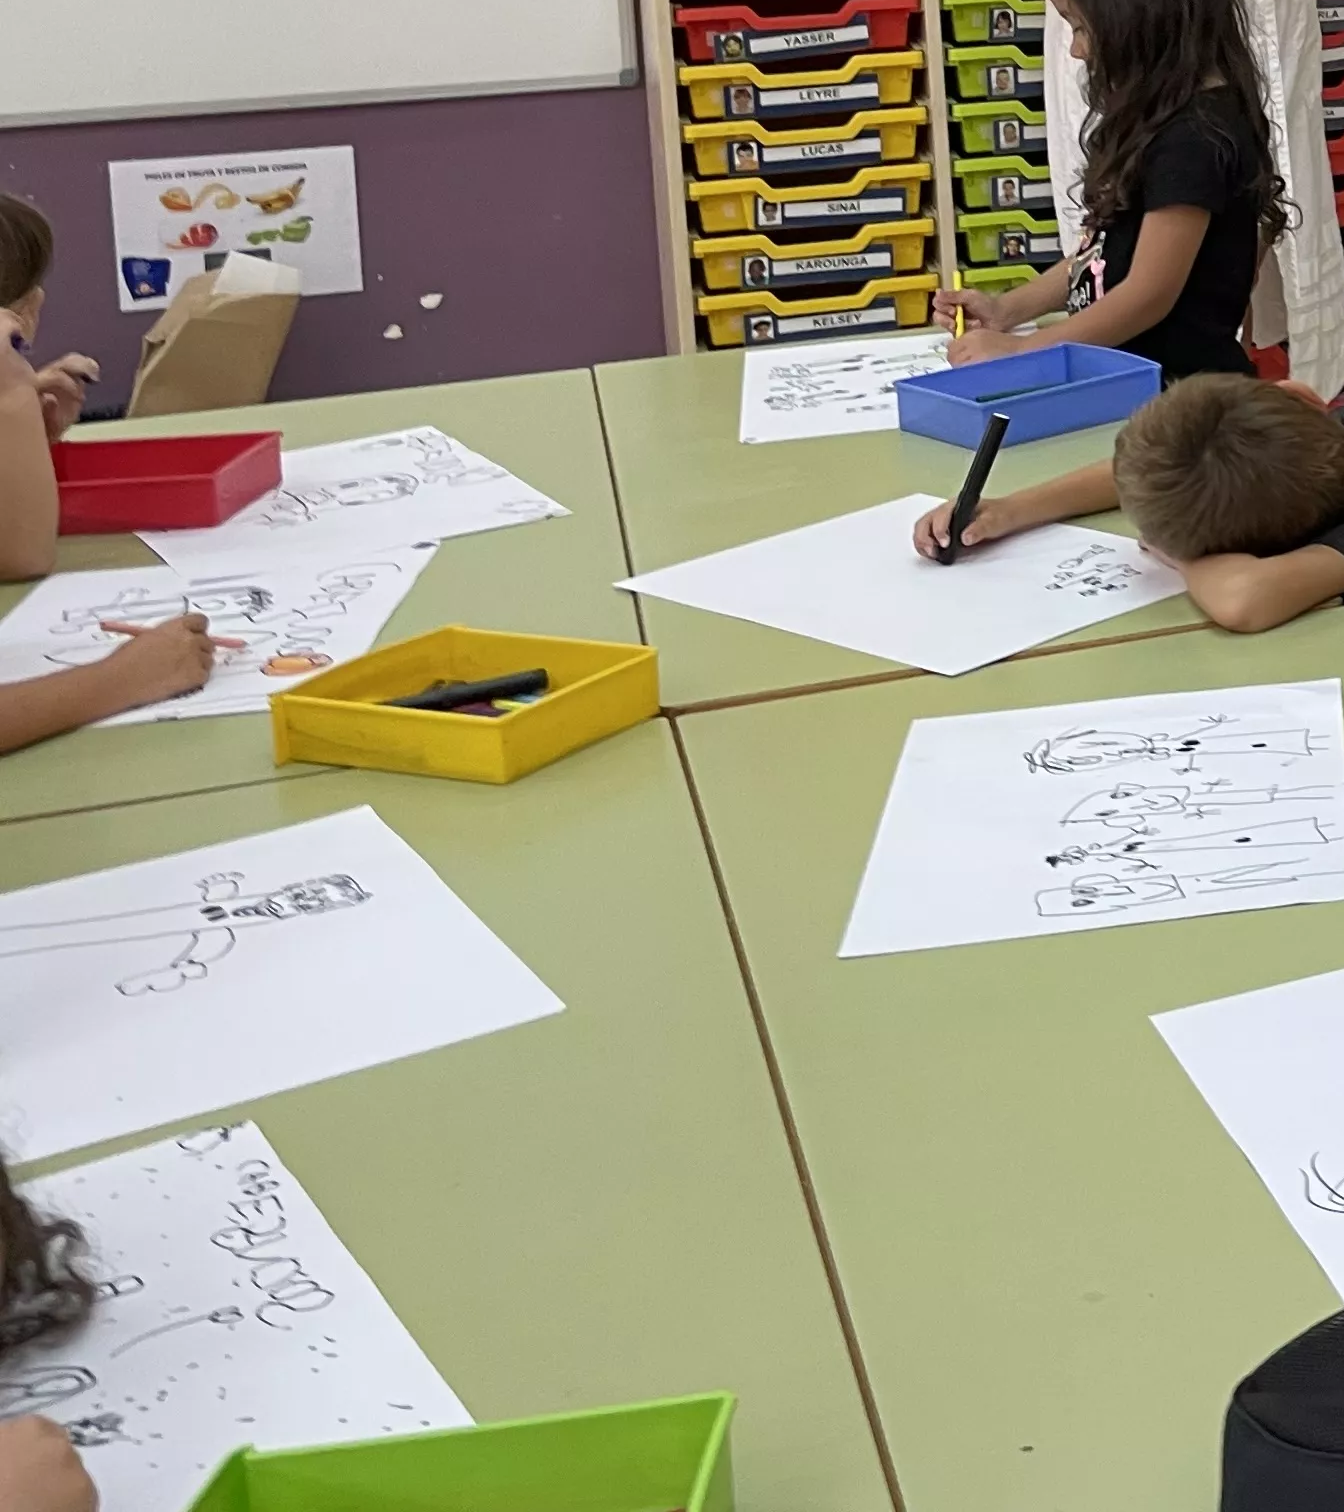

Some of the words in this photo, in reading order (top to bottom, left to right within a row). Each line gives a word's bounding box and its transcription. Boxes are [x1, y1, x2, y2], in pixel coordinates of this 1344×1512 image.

[783, 31, 835, 48] YASSER
[799, 88, 841, 101] LEYRE
[800, 143, 845, 157] LUCAS
[795, 255, 869, 271] KAROUNGA
[812, 312, 863, 328] KELSEY
